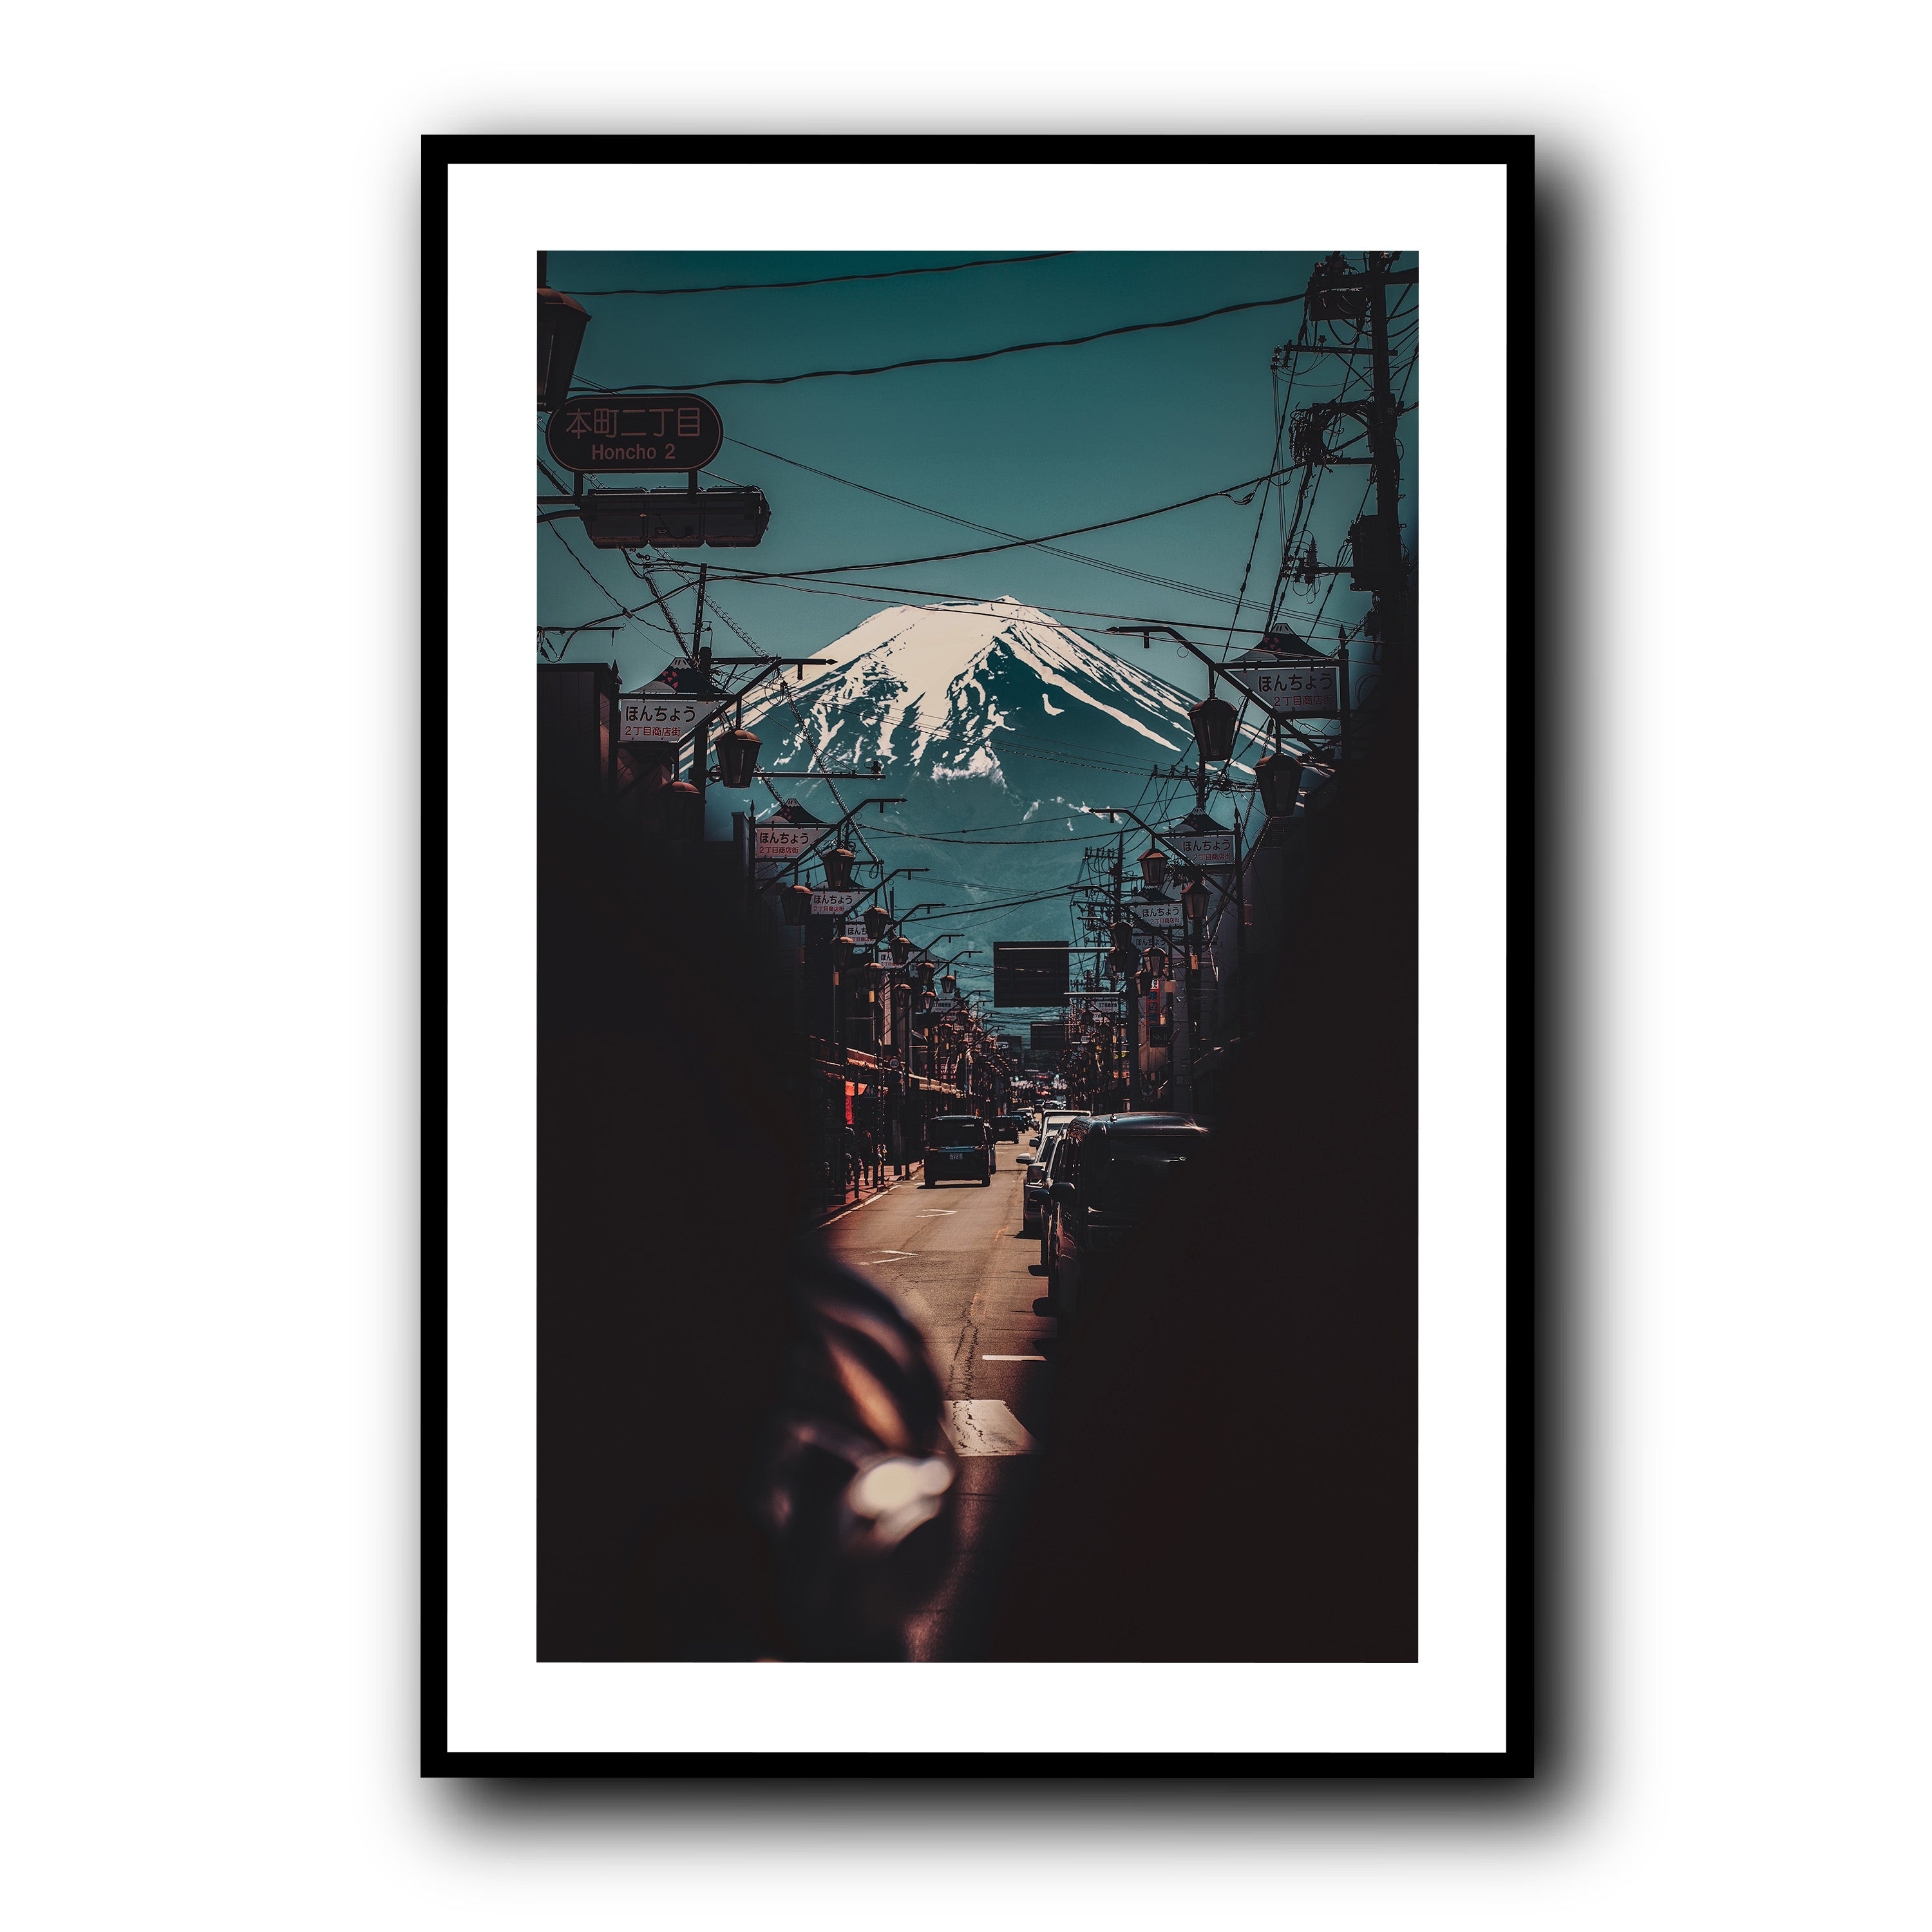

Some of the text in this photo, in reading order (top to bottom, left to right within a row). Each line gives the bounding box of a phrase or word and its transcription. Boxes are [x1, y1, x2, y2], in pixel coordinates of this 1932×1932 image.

[565, 407, 701, 439] 本町二丁目
[592, 443, 676, 460] Honcho 2
[1258, 673, 1332, 692] ほんちょう
[1274, 696, 1332, 706] 2丁目商店街
[625, 705, 696, 723] ほんちょう
[625, 726, 681, 737] 2丁目商店街
[760, 832, 809, 844] ほんちょう
[1183, 839, 1231, 852] ほんちょう
[814, 895, 853, 904] ほんちょう
[1142, 907, 1179, 917] ほんちょう
